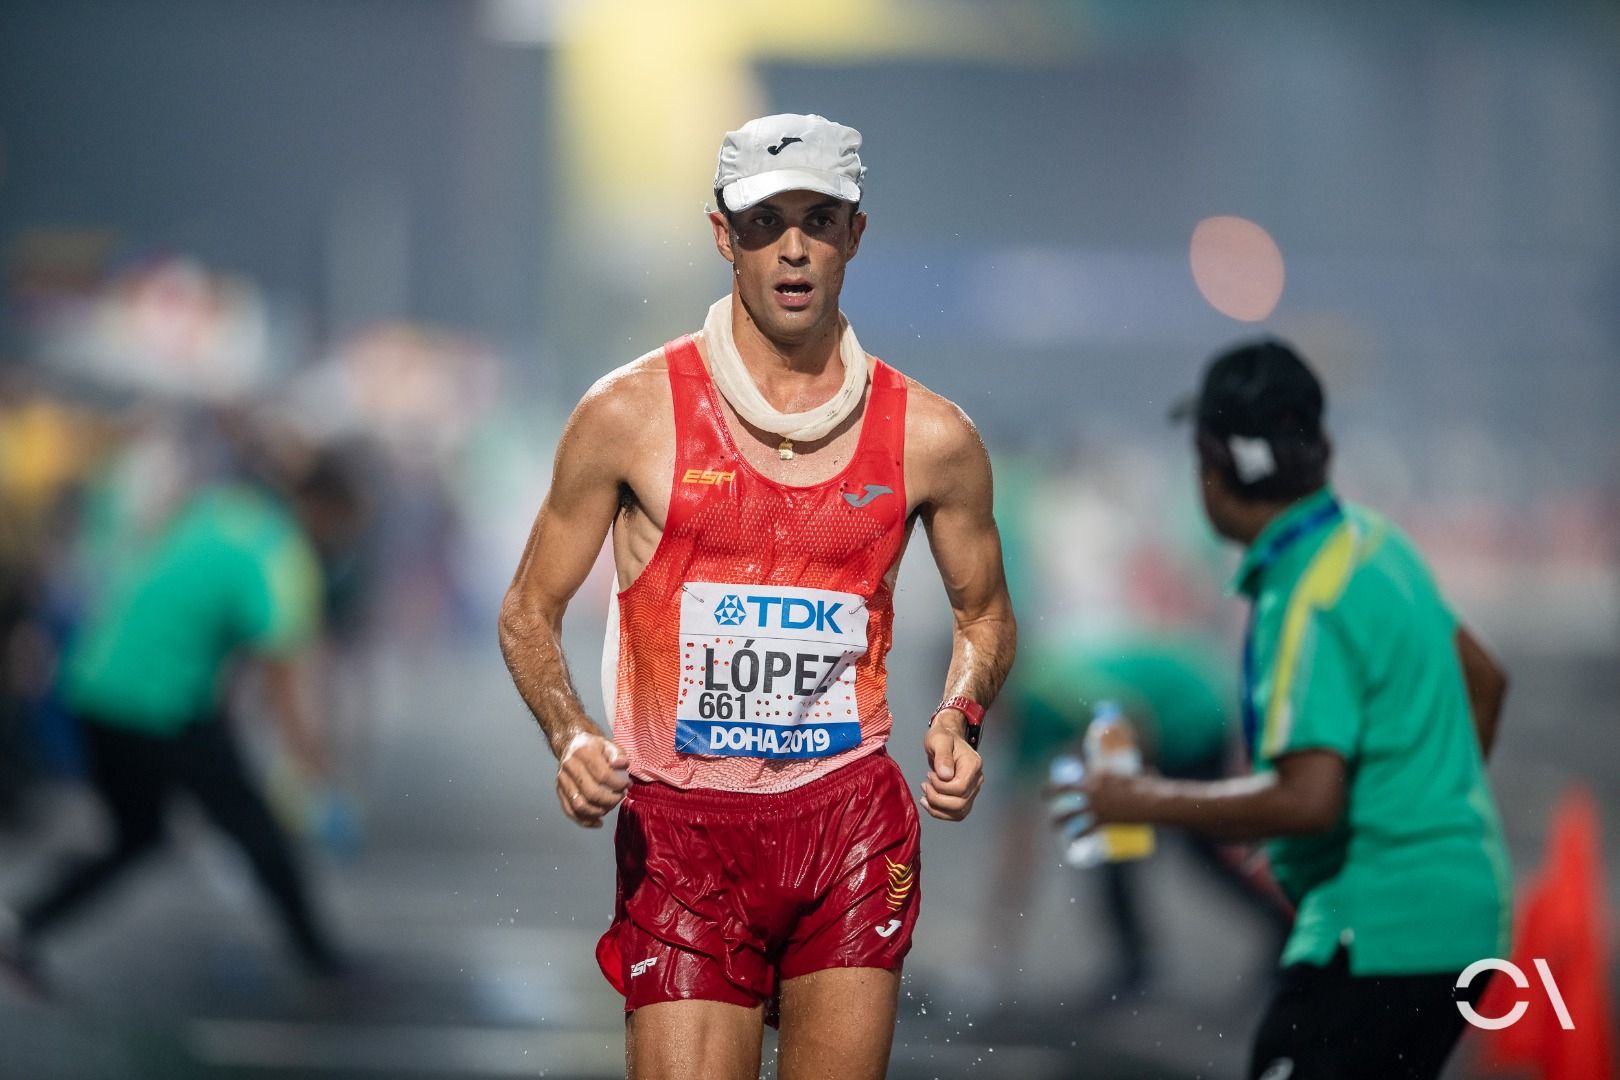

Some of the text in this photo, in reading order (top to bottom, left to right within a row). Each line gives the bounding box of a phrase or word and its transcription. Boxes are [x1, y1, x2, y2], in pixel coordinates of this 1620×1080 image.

[746, 595, 844, 634] TDK
[704, 639, 842, 696] LÓPEZ
[699, 692, 746, 720] 661
